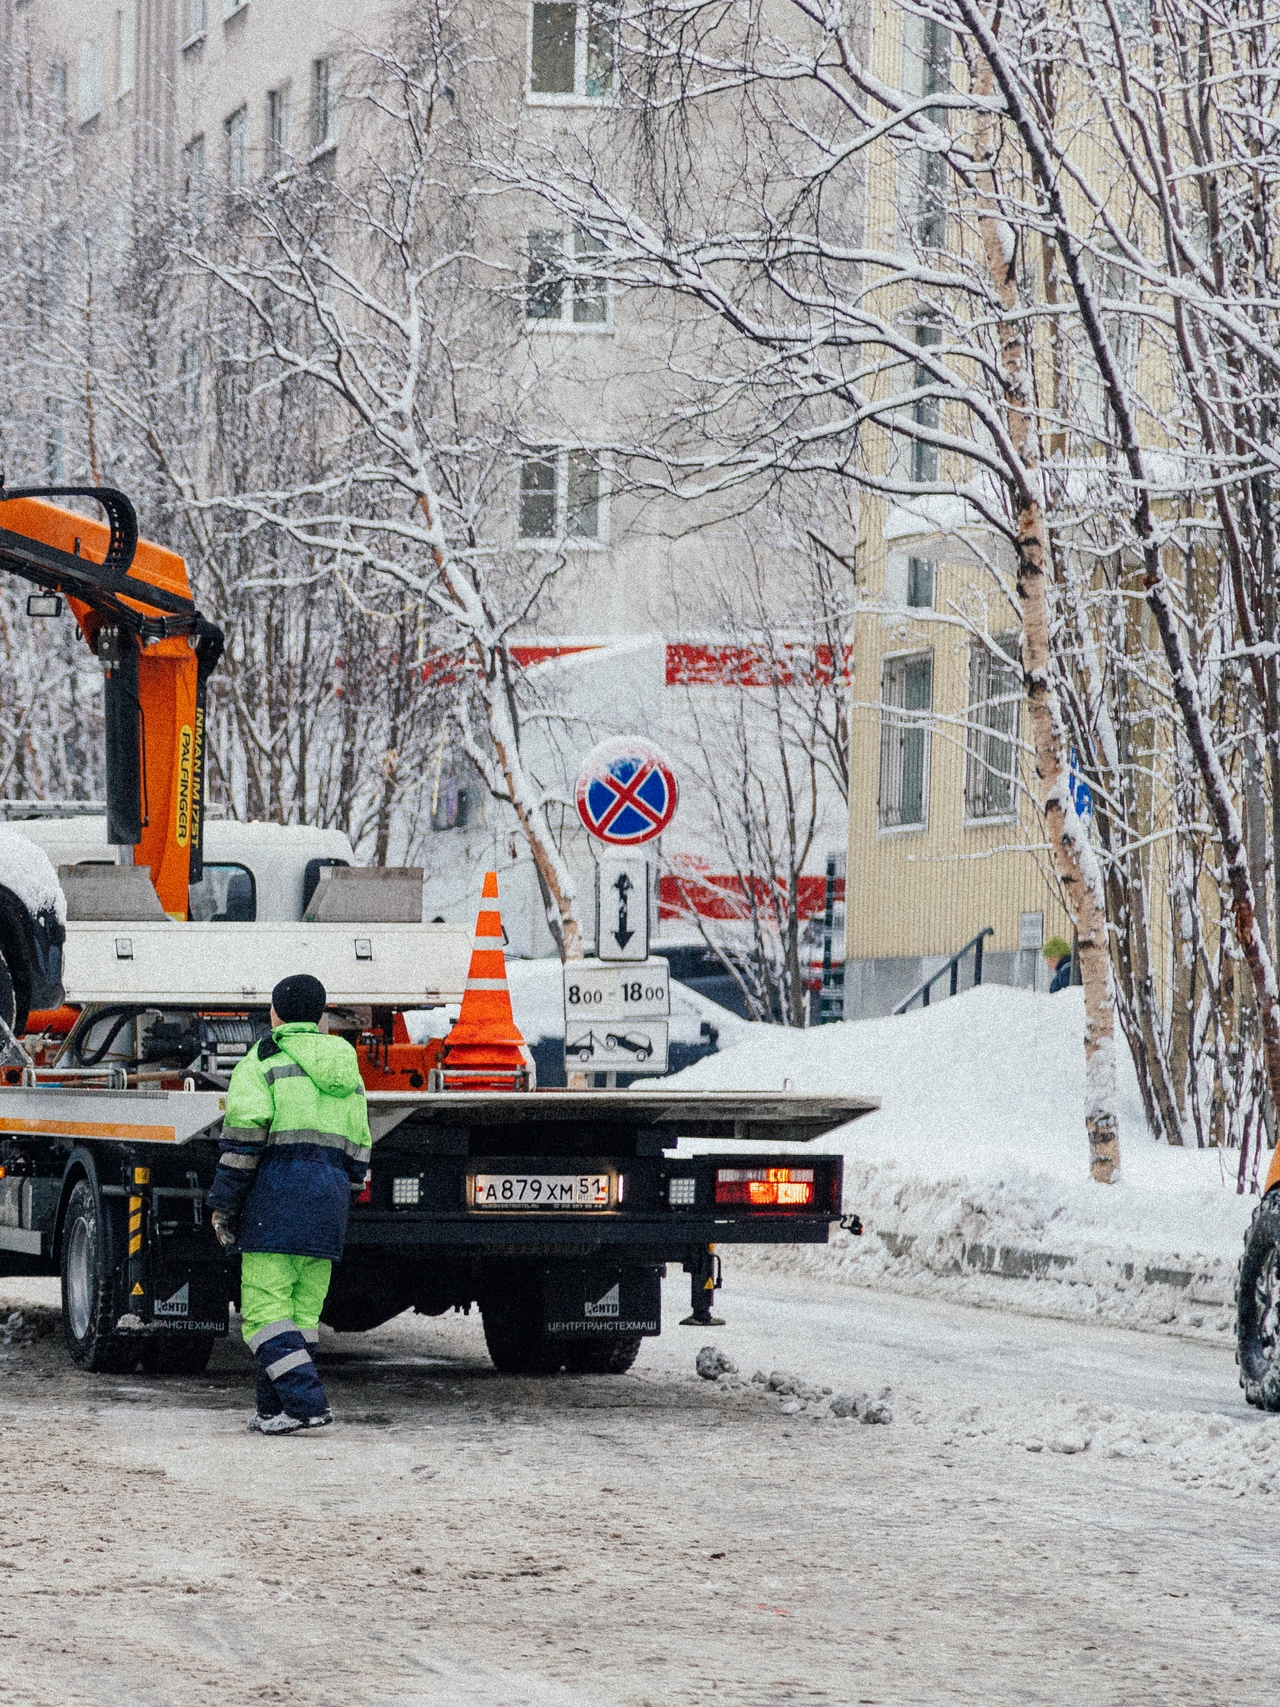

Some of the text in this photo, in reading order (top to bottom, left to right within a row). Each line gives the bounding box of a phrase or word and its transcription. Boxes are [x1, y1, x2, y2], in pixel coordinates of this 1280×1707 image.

[194, 707, 204, 773] INMAN
[178, 732, 191, 839] PALFINGER
[579, 1178, 601, 1195] 51
[548, 1320, 657, 1332] ЦЕНТРТРАНСТЕХМАШ
